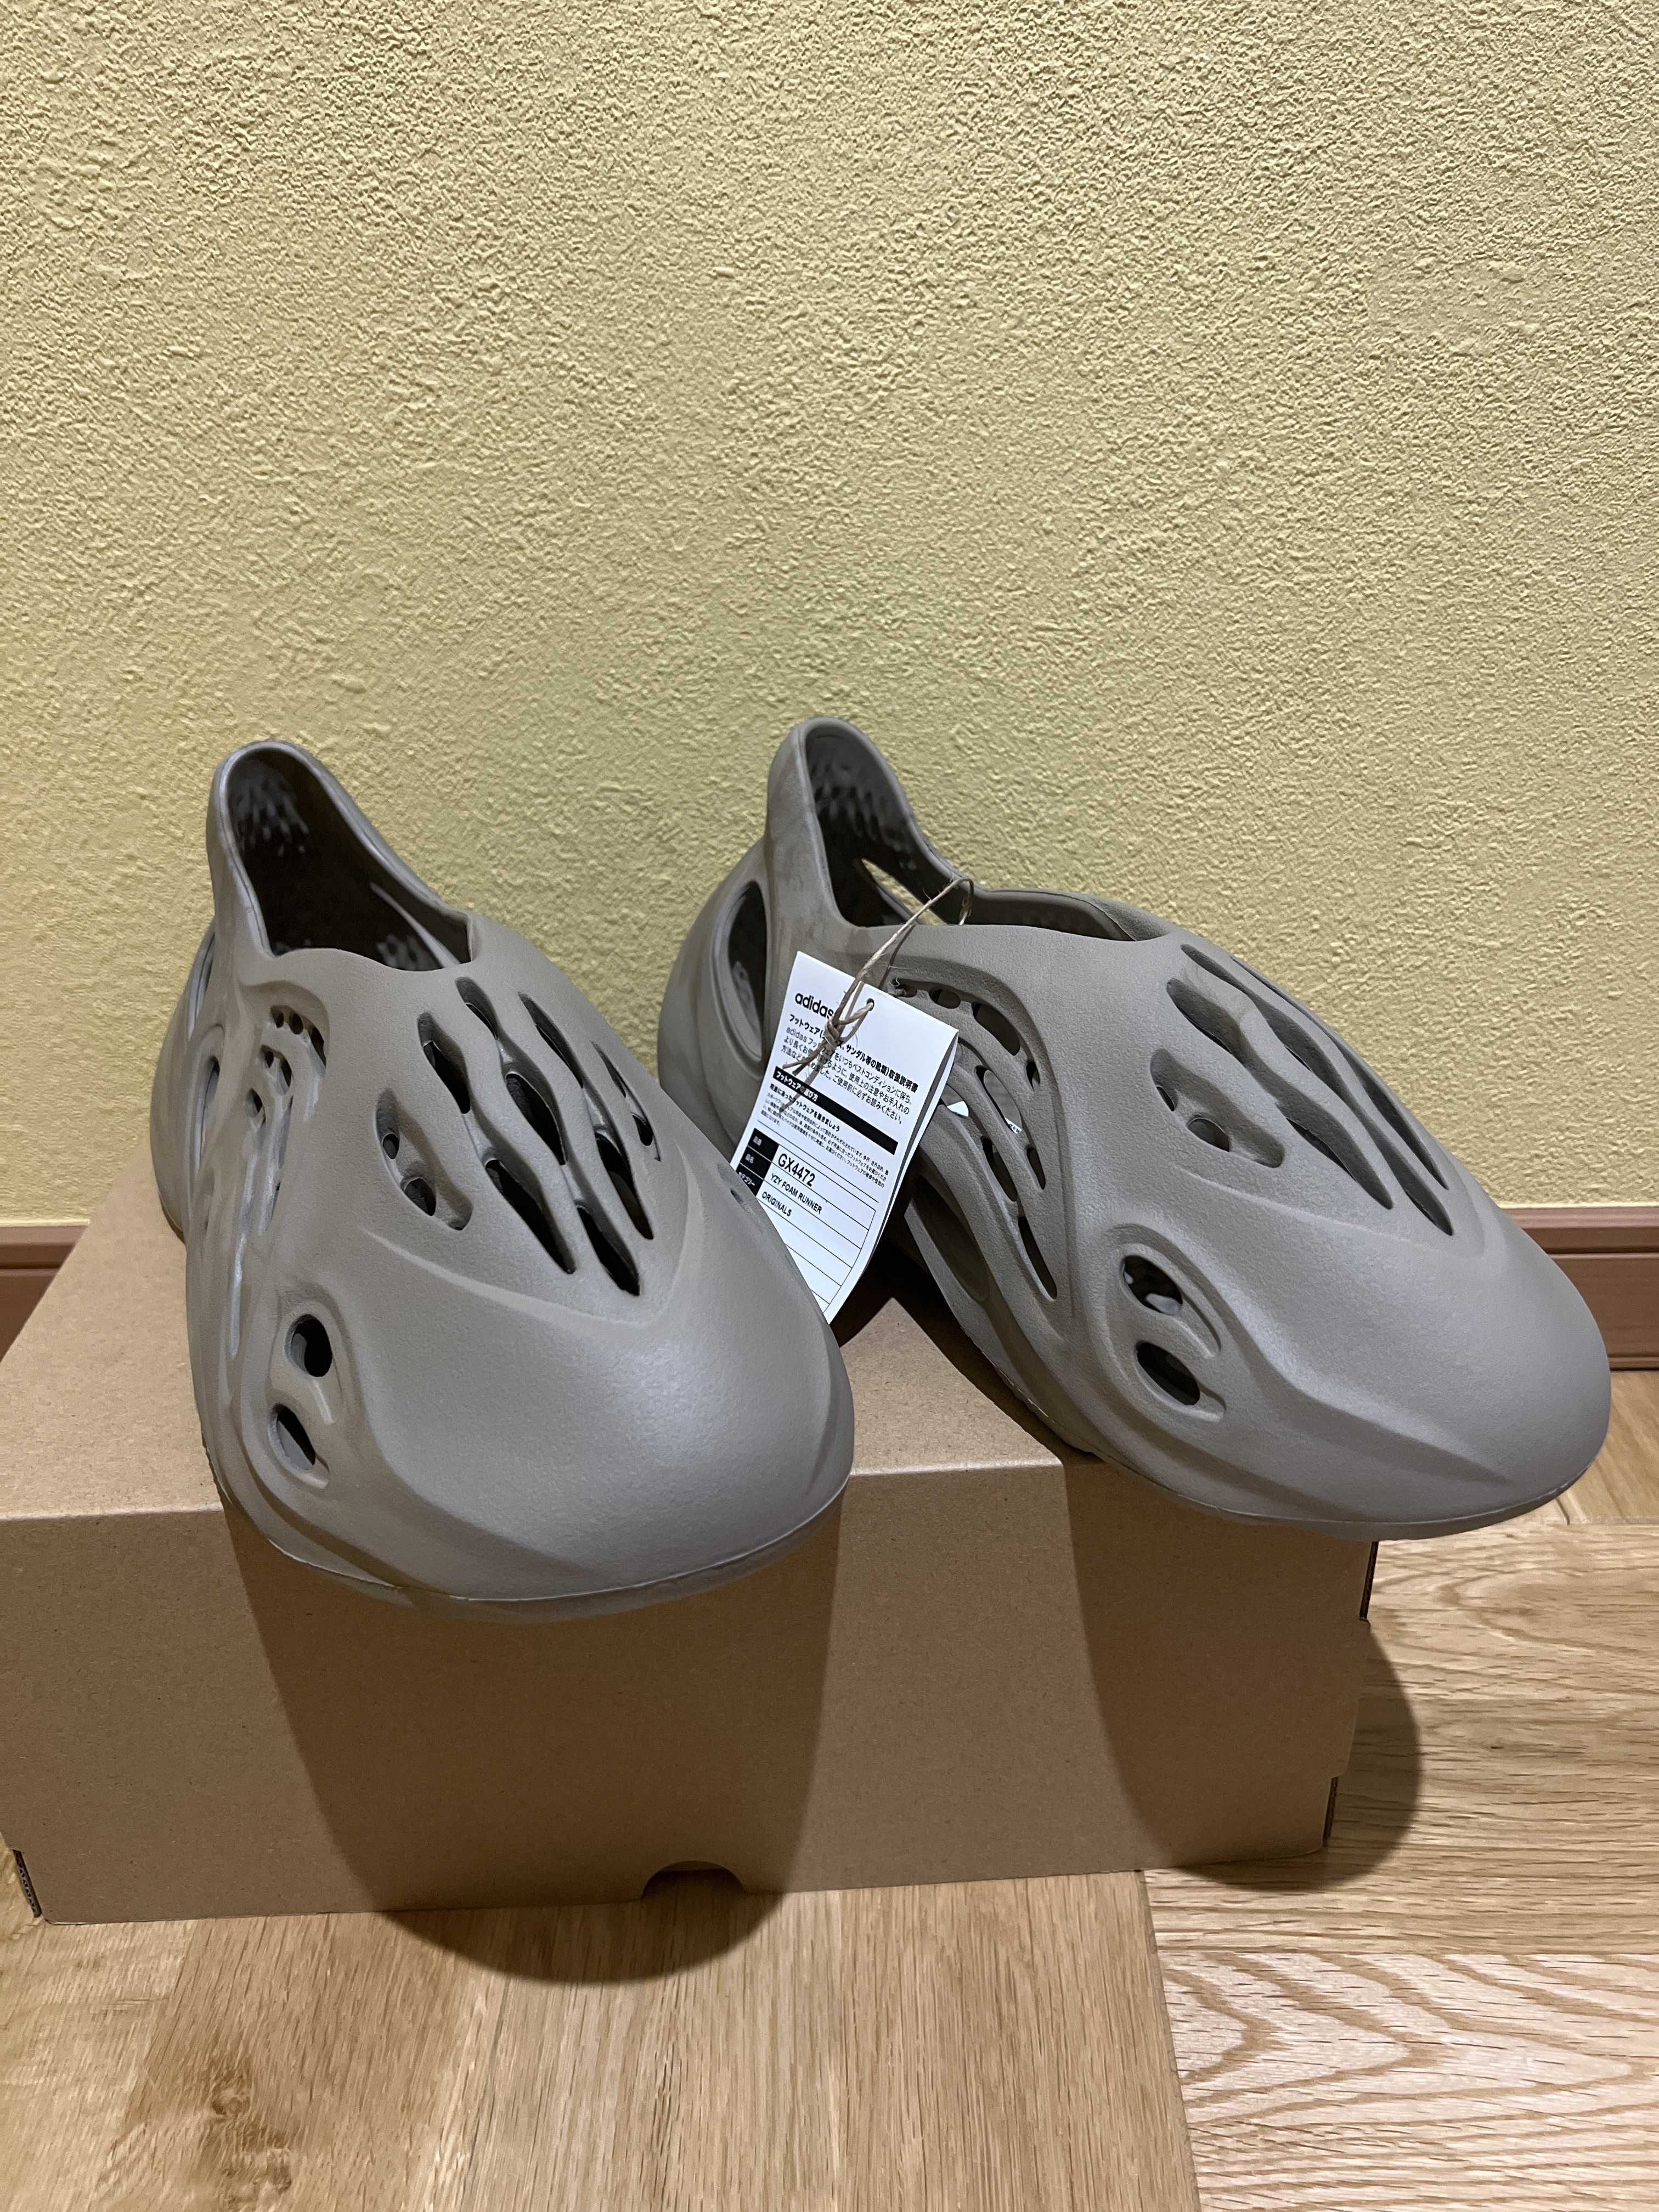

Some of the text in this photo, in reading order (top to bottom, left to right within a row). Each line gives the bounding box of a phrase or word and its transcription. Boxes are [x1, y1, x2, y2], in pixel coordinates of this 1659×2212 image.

[794, 992, 834, 1020] adidas
[785, 1025, 808, 1043] adidas
[776, 1152, 817, 1188] GX4472
[761, 1190, 793, 1217] ORIGINALS
[769, 1172, 822, 1215] YZY FOAM RUNNER
